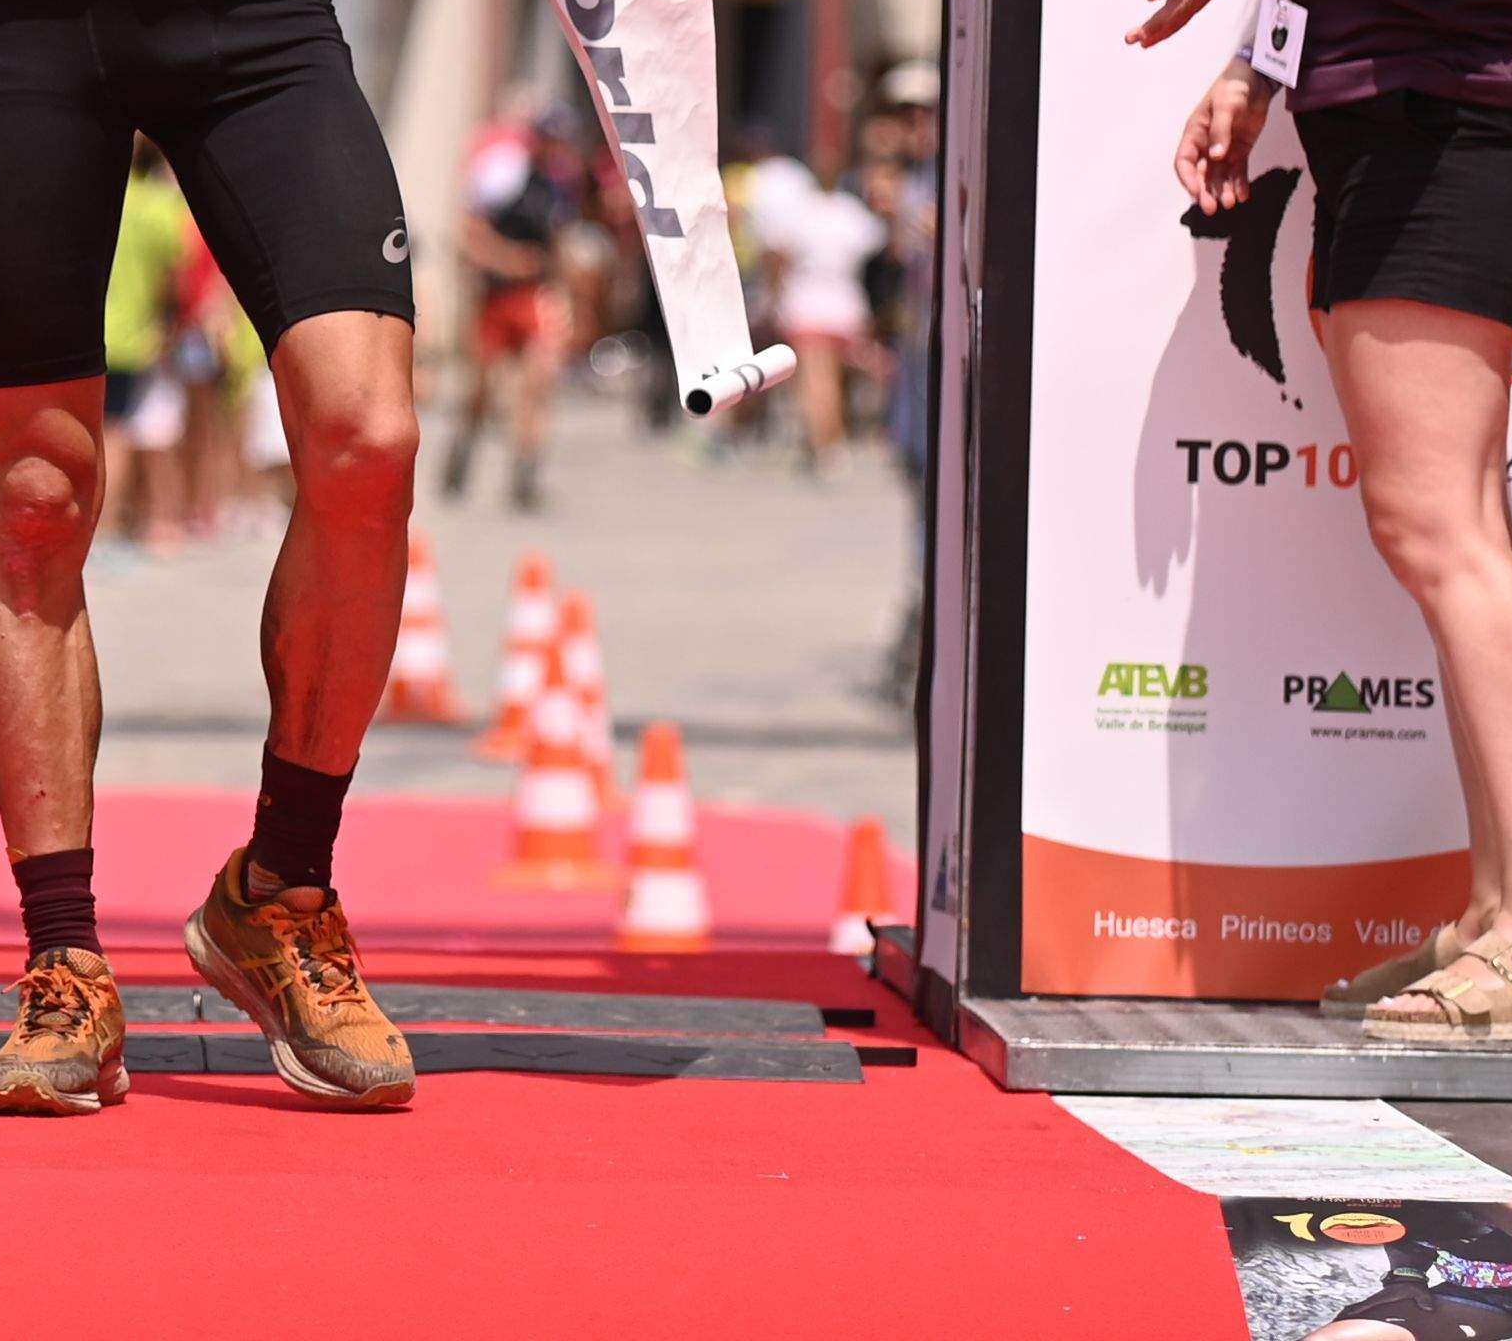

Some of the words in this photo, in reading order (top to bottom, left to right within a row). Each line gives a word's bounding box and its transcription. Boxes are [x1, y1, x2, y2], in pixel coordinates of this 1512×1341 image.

[1097, 662, 1209, 699] ATEVB
[1093, 910, 1197, 940] Huesca
[1220, 914, 1332, 945] Pirineos
[1355, 917, 1421, 947] Valle
